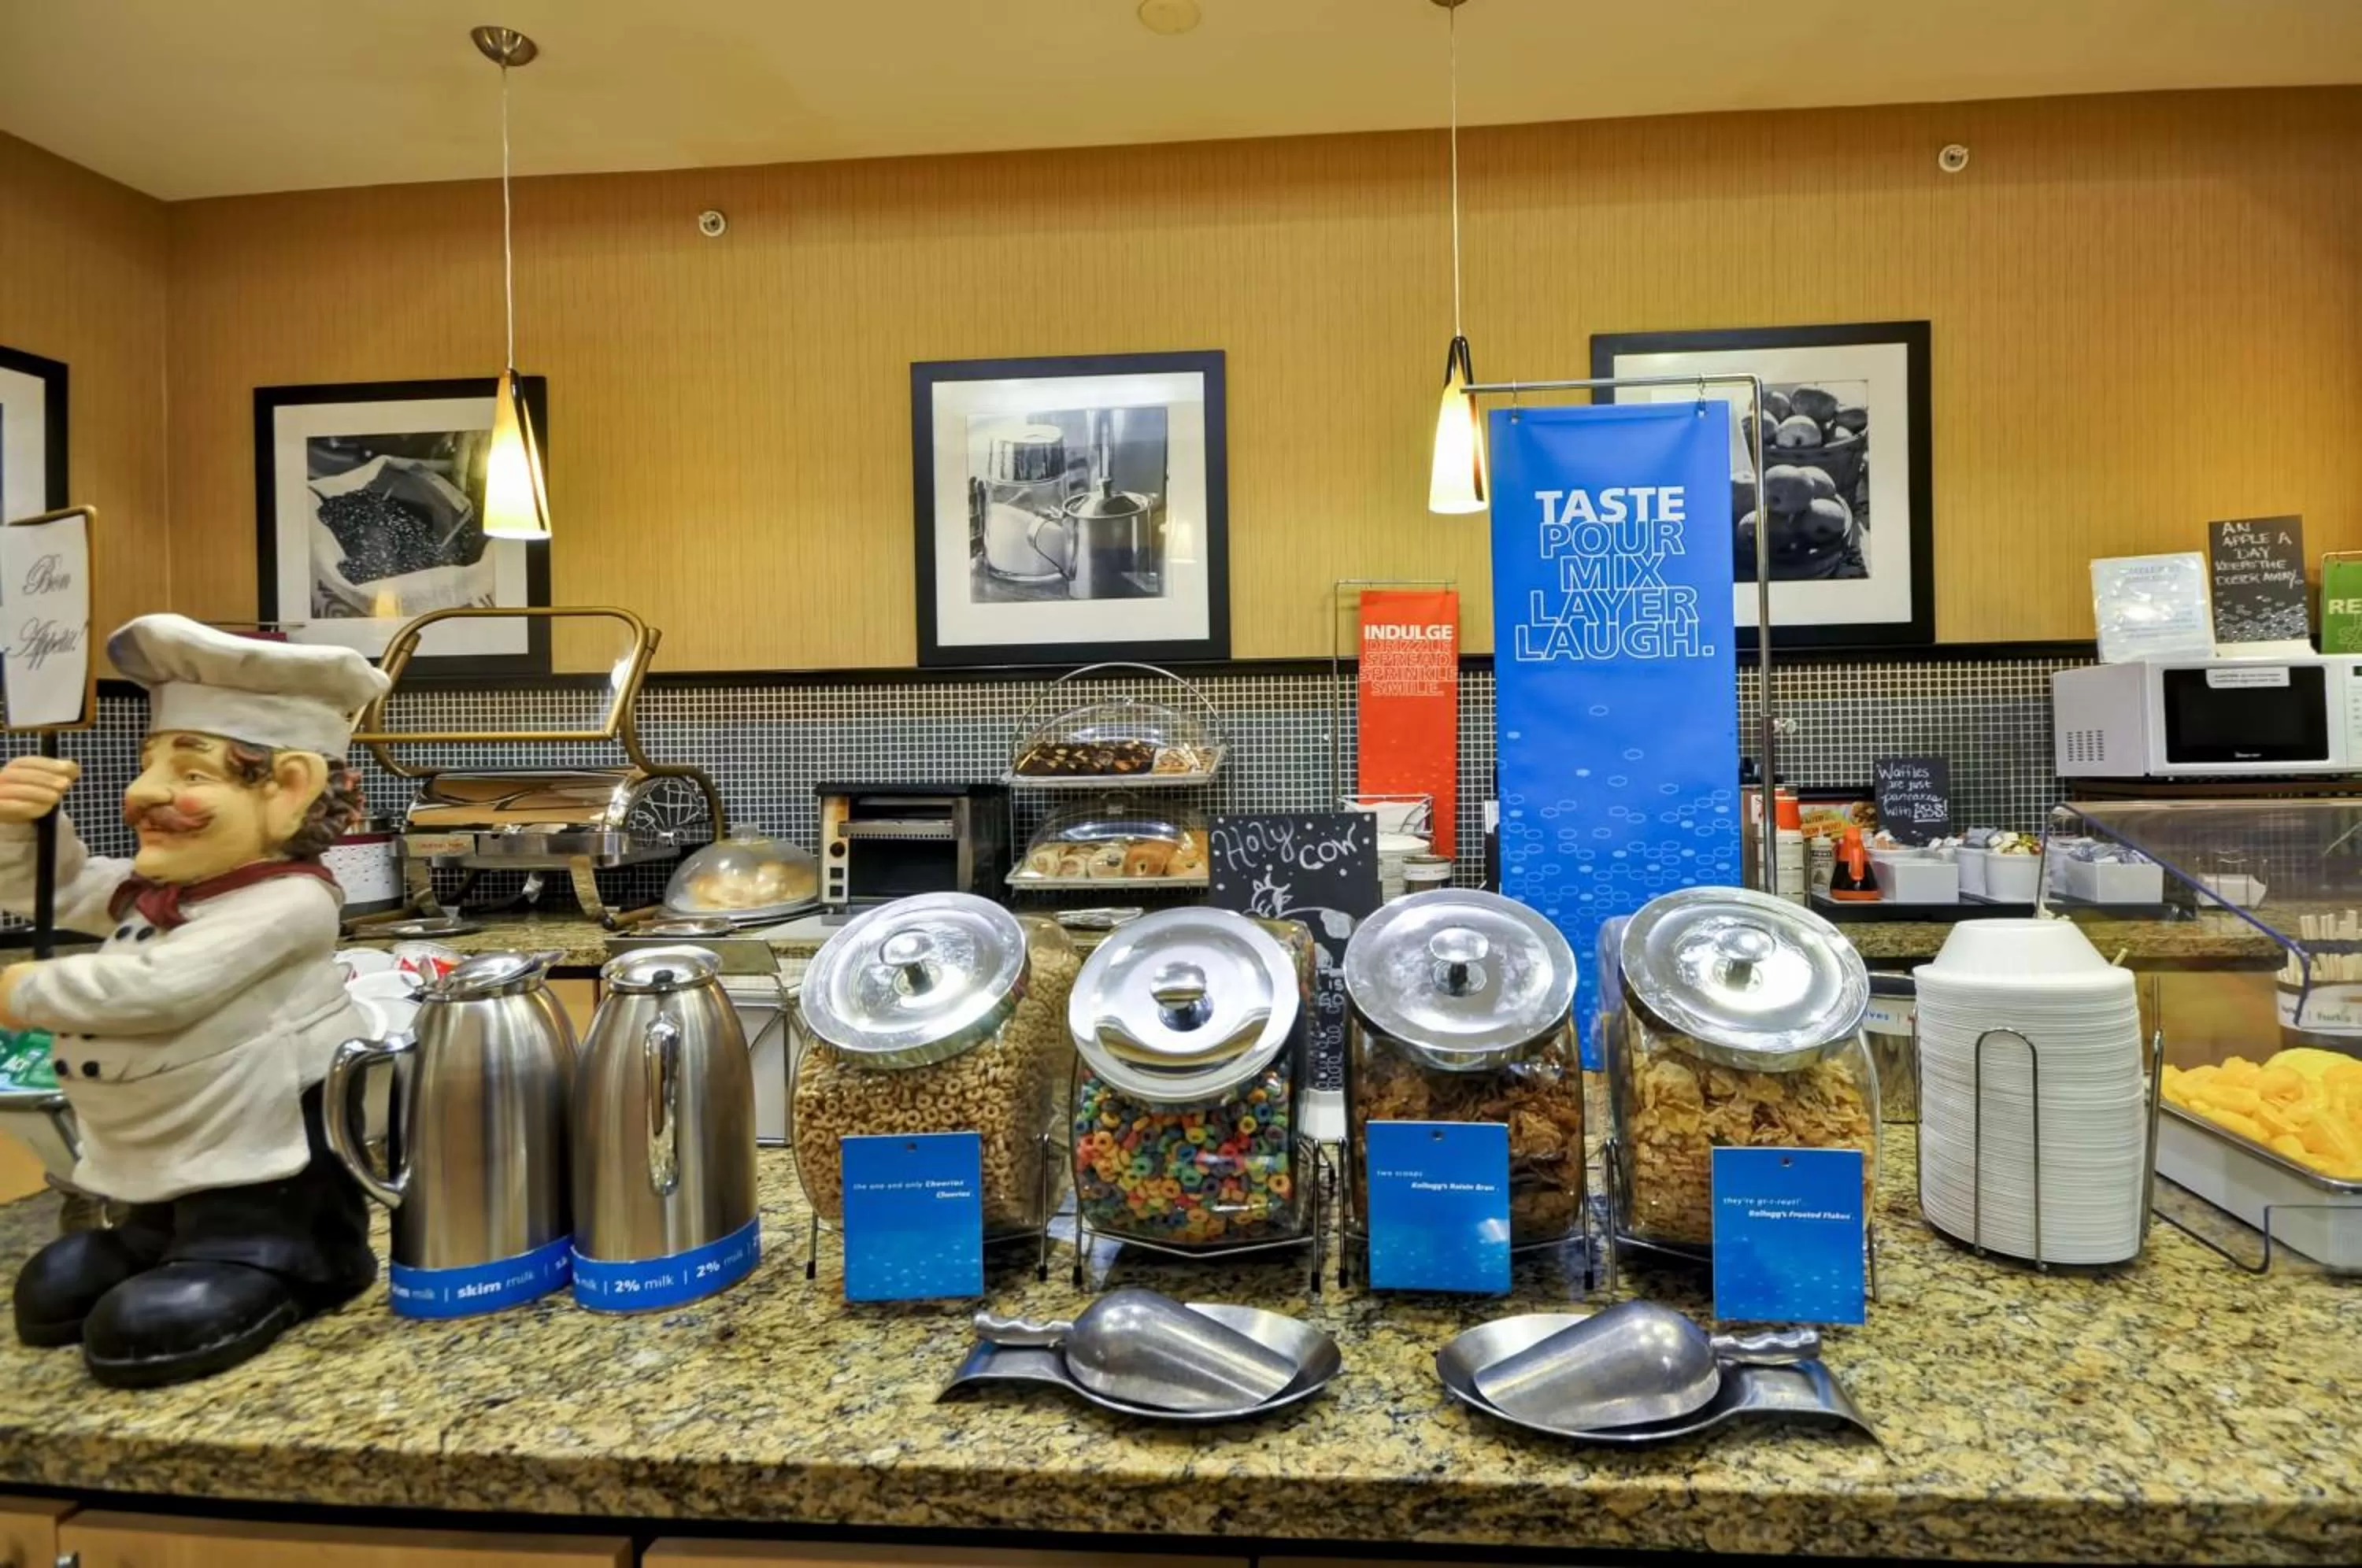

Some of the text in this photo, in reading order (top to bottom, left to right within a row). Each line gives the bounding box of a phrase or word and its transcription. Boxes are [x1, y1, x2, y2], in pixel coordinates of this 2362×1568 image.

[1535, 486, 1686, 525] TASTE
[1540, 519, 1686, 559] POUR
[2222, 522, 2251, 536] AN
[2222, 531, 2294, 548] APPLE A
[2234, 545, 2271, 560] DAY
[22, 553, 72, 595] Bon
[1560, 553, 1666, 592] MIX
[1530, 586, 1699, 627] LAYER
[1364, 624, 1454, 641] INDULGE
[1515, 620, 1716, 662] LAUGH.
[1364, 651, 1452, 667] SPREAD
[1211, 819, 1295, 871] Holy
[457, 1281, 502, 1299] skim
[614, 1280, 641, 1294] 2%
[644, 1274, 675, 1290] milk
[695, 1260, 720, 1279] 2%
